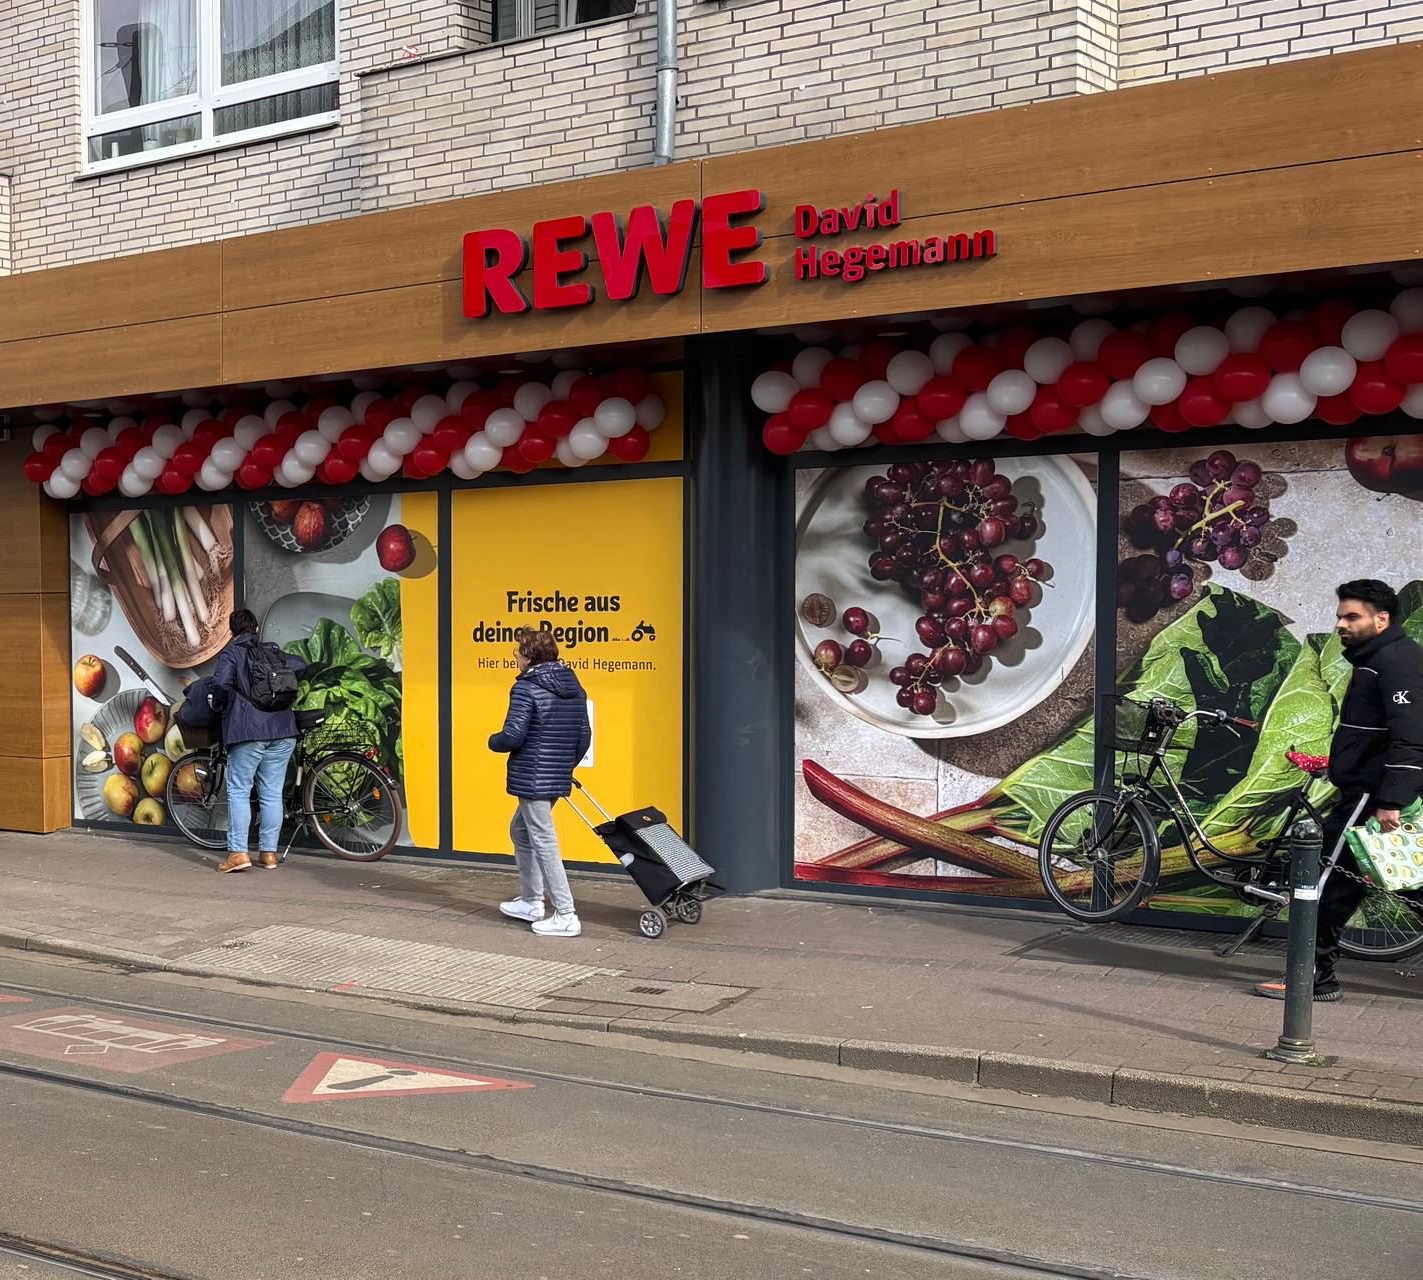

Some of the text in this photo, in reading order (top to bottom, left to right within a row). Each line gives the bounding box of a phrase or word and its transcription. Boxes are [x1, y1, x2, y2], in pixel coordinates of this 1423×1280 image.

[794, 189, 902, 239] David
[463, 189, 767, 317] REWE
[794, 228, 998, 283] Hegemann
[506, 590, 620, 613] Frische aus
[472, 620, 524, 643] deine
[478, 657, 499, 669] Hier
[593, 658, 657, 673] Hegemann.
